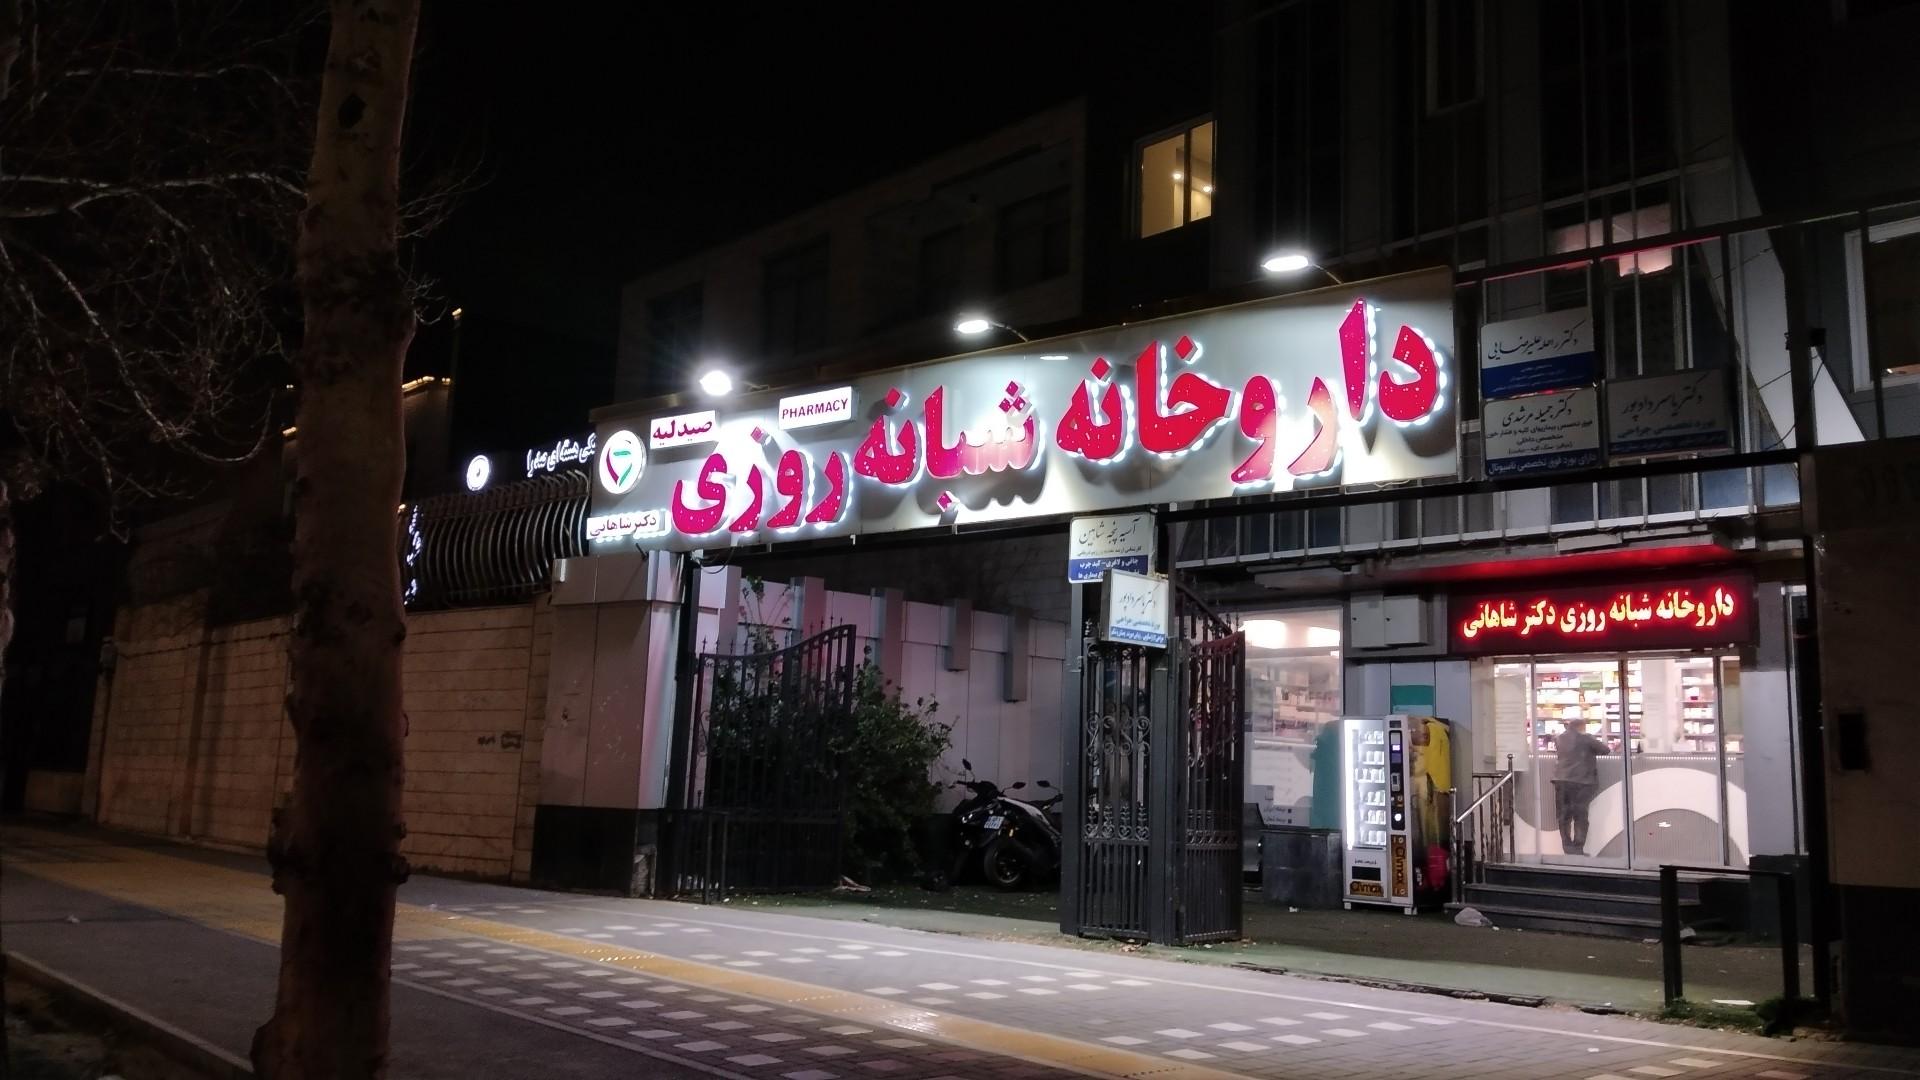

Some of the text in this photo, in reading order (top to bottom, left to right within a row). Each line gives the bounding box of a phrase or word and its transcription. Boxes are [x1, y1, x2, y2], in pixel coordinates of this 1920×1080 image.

[671, 297, 1443, 535] داروخانه شبانه روزی
[781, 397, 849, 420] PHARMACY
[652, 419, 713, 446] صیدلیه
[1463, 586, 1734, 638] داروخانه شبانه روزی دکتر شاهانی
